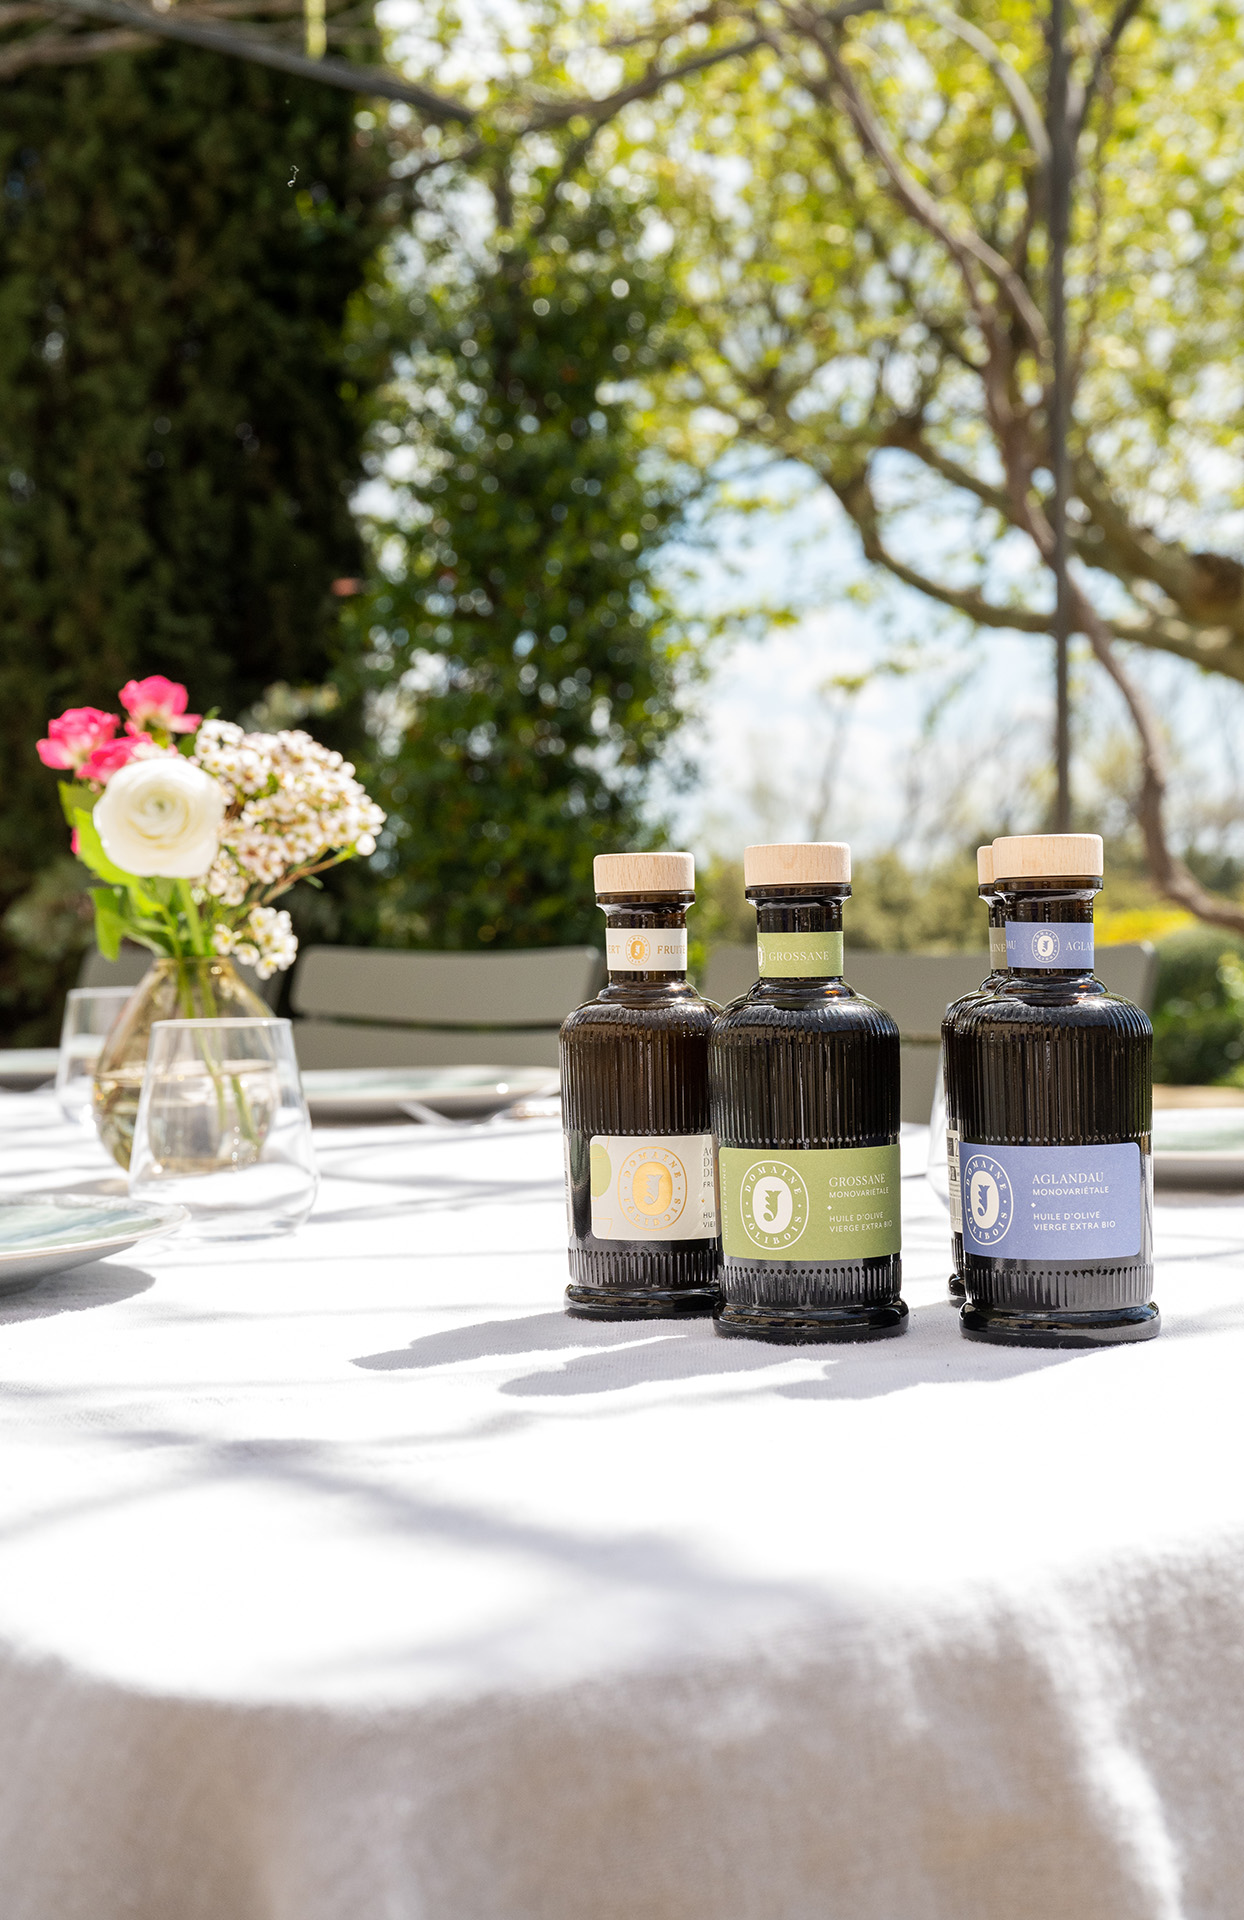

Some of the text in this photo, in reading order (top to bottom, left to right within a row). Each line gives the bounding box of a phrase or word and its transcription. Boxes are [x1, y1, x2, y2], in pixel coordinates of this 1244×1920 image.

[768, 951, 830, 961] GROSSANE
[623, 1151, 682, 1178] DOMAINE
[744, 1165, 803, 1195] DOMAINE
[828, 1173, 886, 1188] GROSSANE
[965, 1160, 1007, 1191] DOMAINE
[1032, 1171, 1104, 1185] AGLANDAU
[1032, 1185, 1110, 1197] MONOVARIÉTALE
[829, 1211, 884, 1223] HUILE D'OLIVE
[1033, 1210, 1101, 1221] HUILE D'OLIVE
[829, 1219, 893, 1233] VIERGE EXTRA BIO
[1033, 1219, 1116, 1231] VIERGE EXTRA BIO
